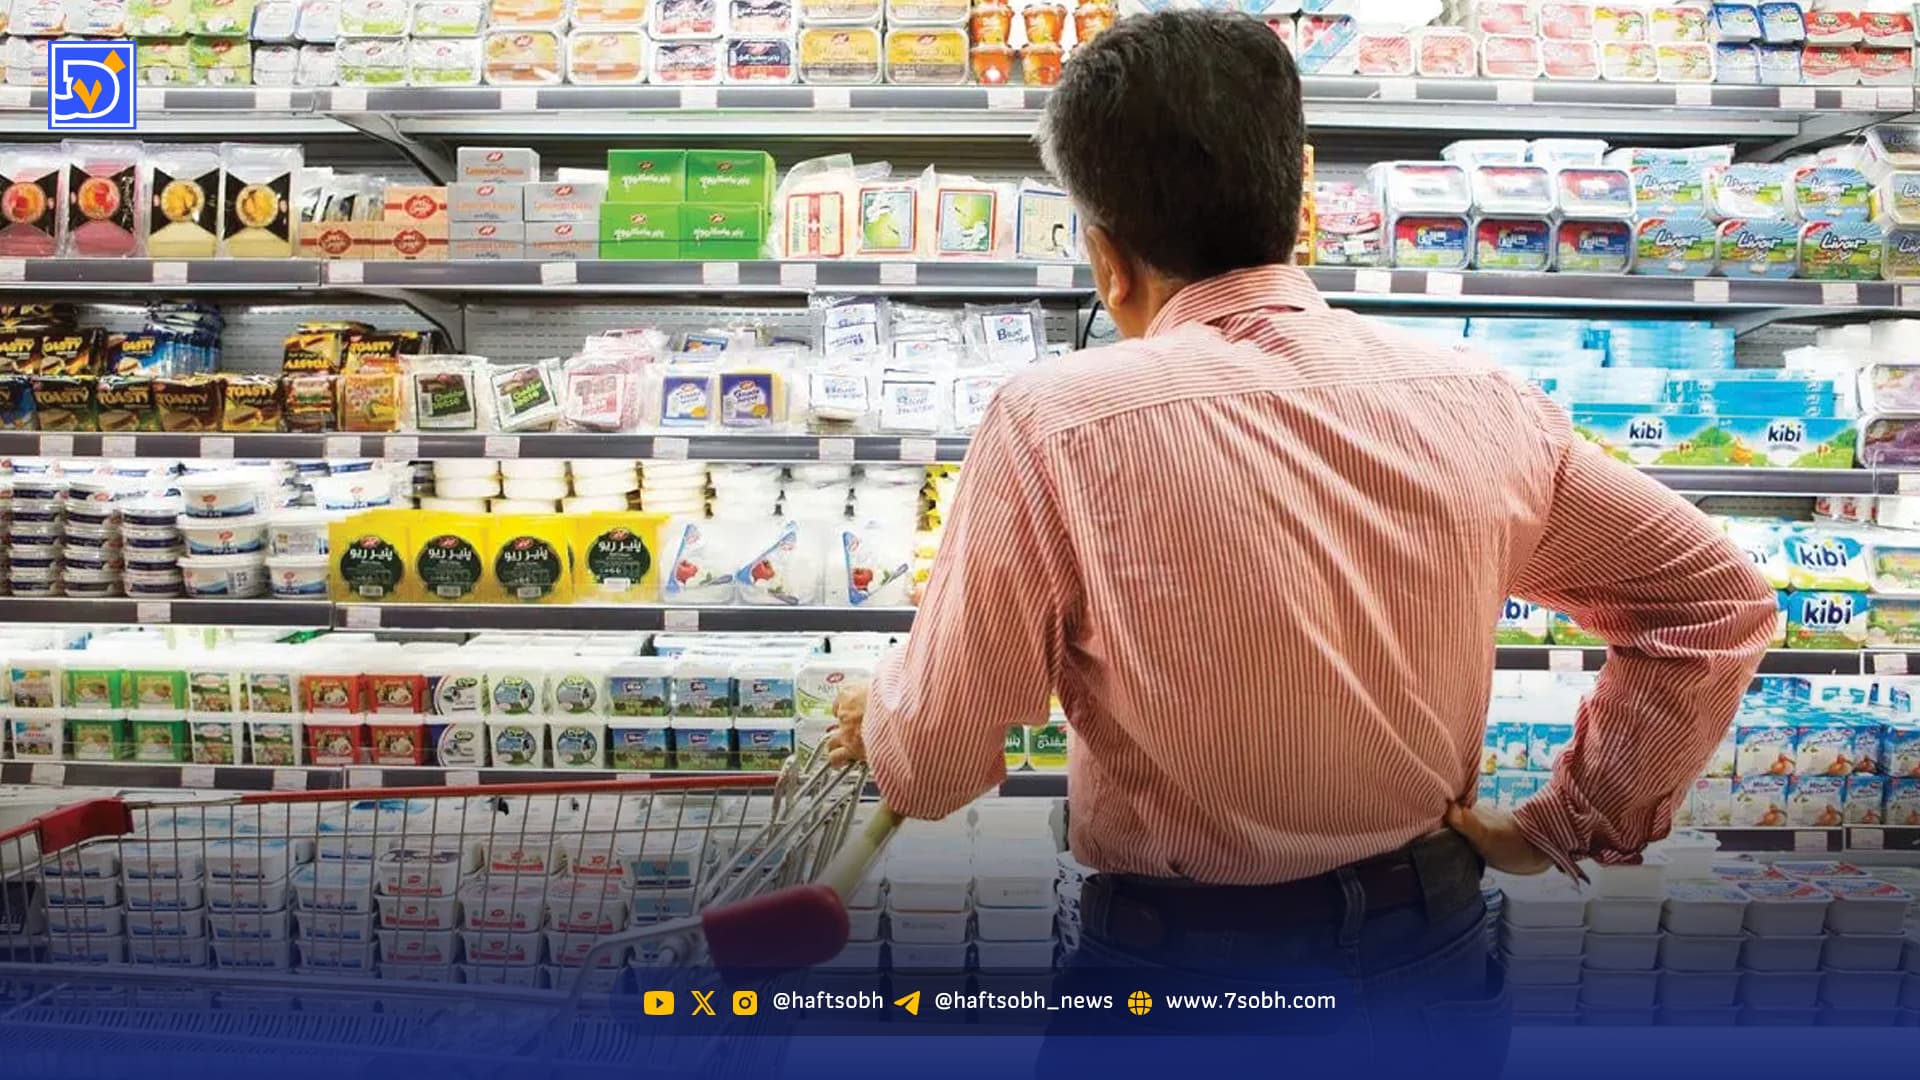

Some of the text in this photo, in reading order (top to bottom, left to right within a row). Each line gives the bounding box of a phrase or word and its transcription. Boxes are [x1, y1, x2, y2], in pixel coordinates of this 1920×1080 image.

[1656, 229, 1702, 249] Livar
[1736, 231, 1783, 251] Livar
[1819, 232, 1868, 251] Livar
[349, 341, 394, 354] TOASTY
[37, 388, 89, 404] TOASTY
[98, 388, 149, 404] TOASTY
[156, 392, 209, 406] TOASTY
[227, 385, 275, 399] TOASTY
[1630, 422, 1663, 440] kibi
[1768, 424, 1802, 442] kibi
[369, 547, 393, 561] پنیر
[447, 548, 472, 561] پنیر
[524, 547, 549, 561] پنیر
[618, 539, 642, 554] پنیر
[1799, 544, 1847, 568] kibi
[1804, 599, 1852, 625] kibi
